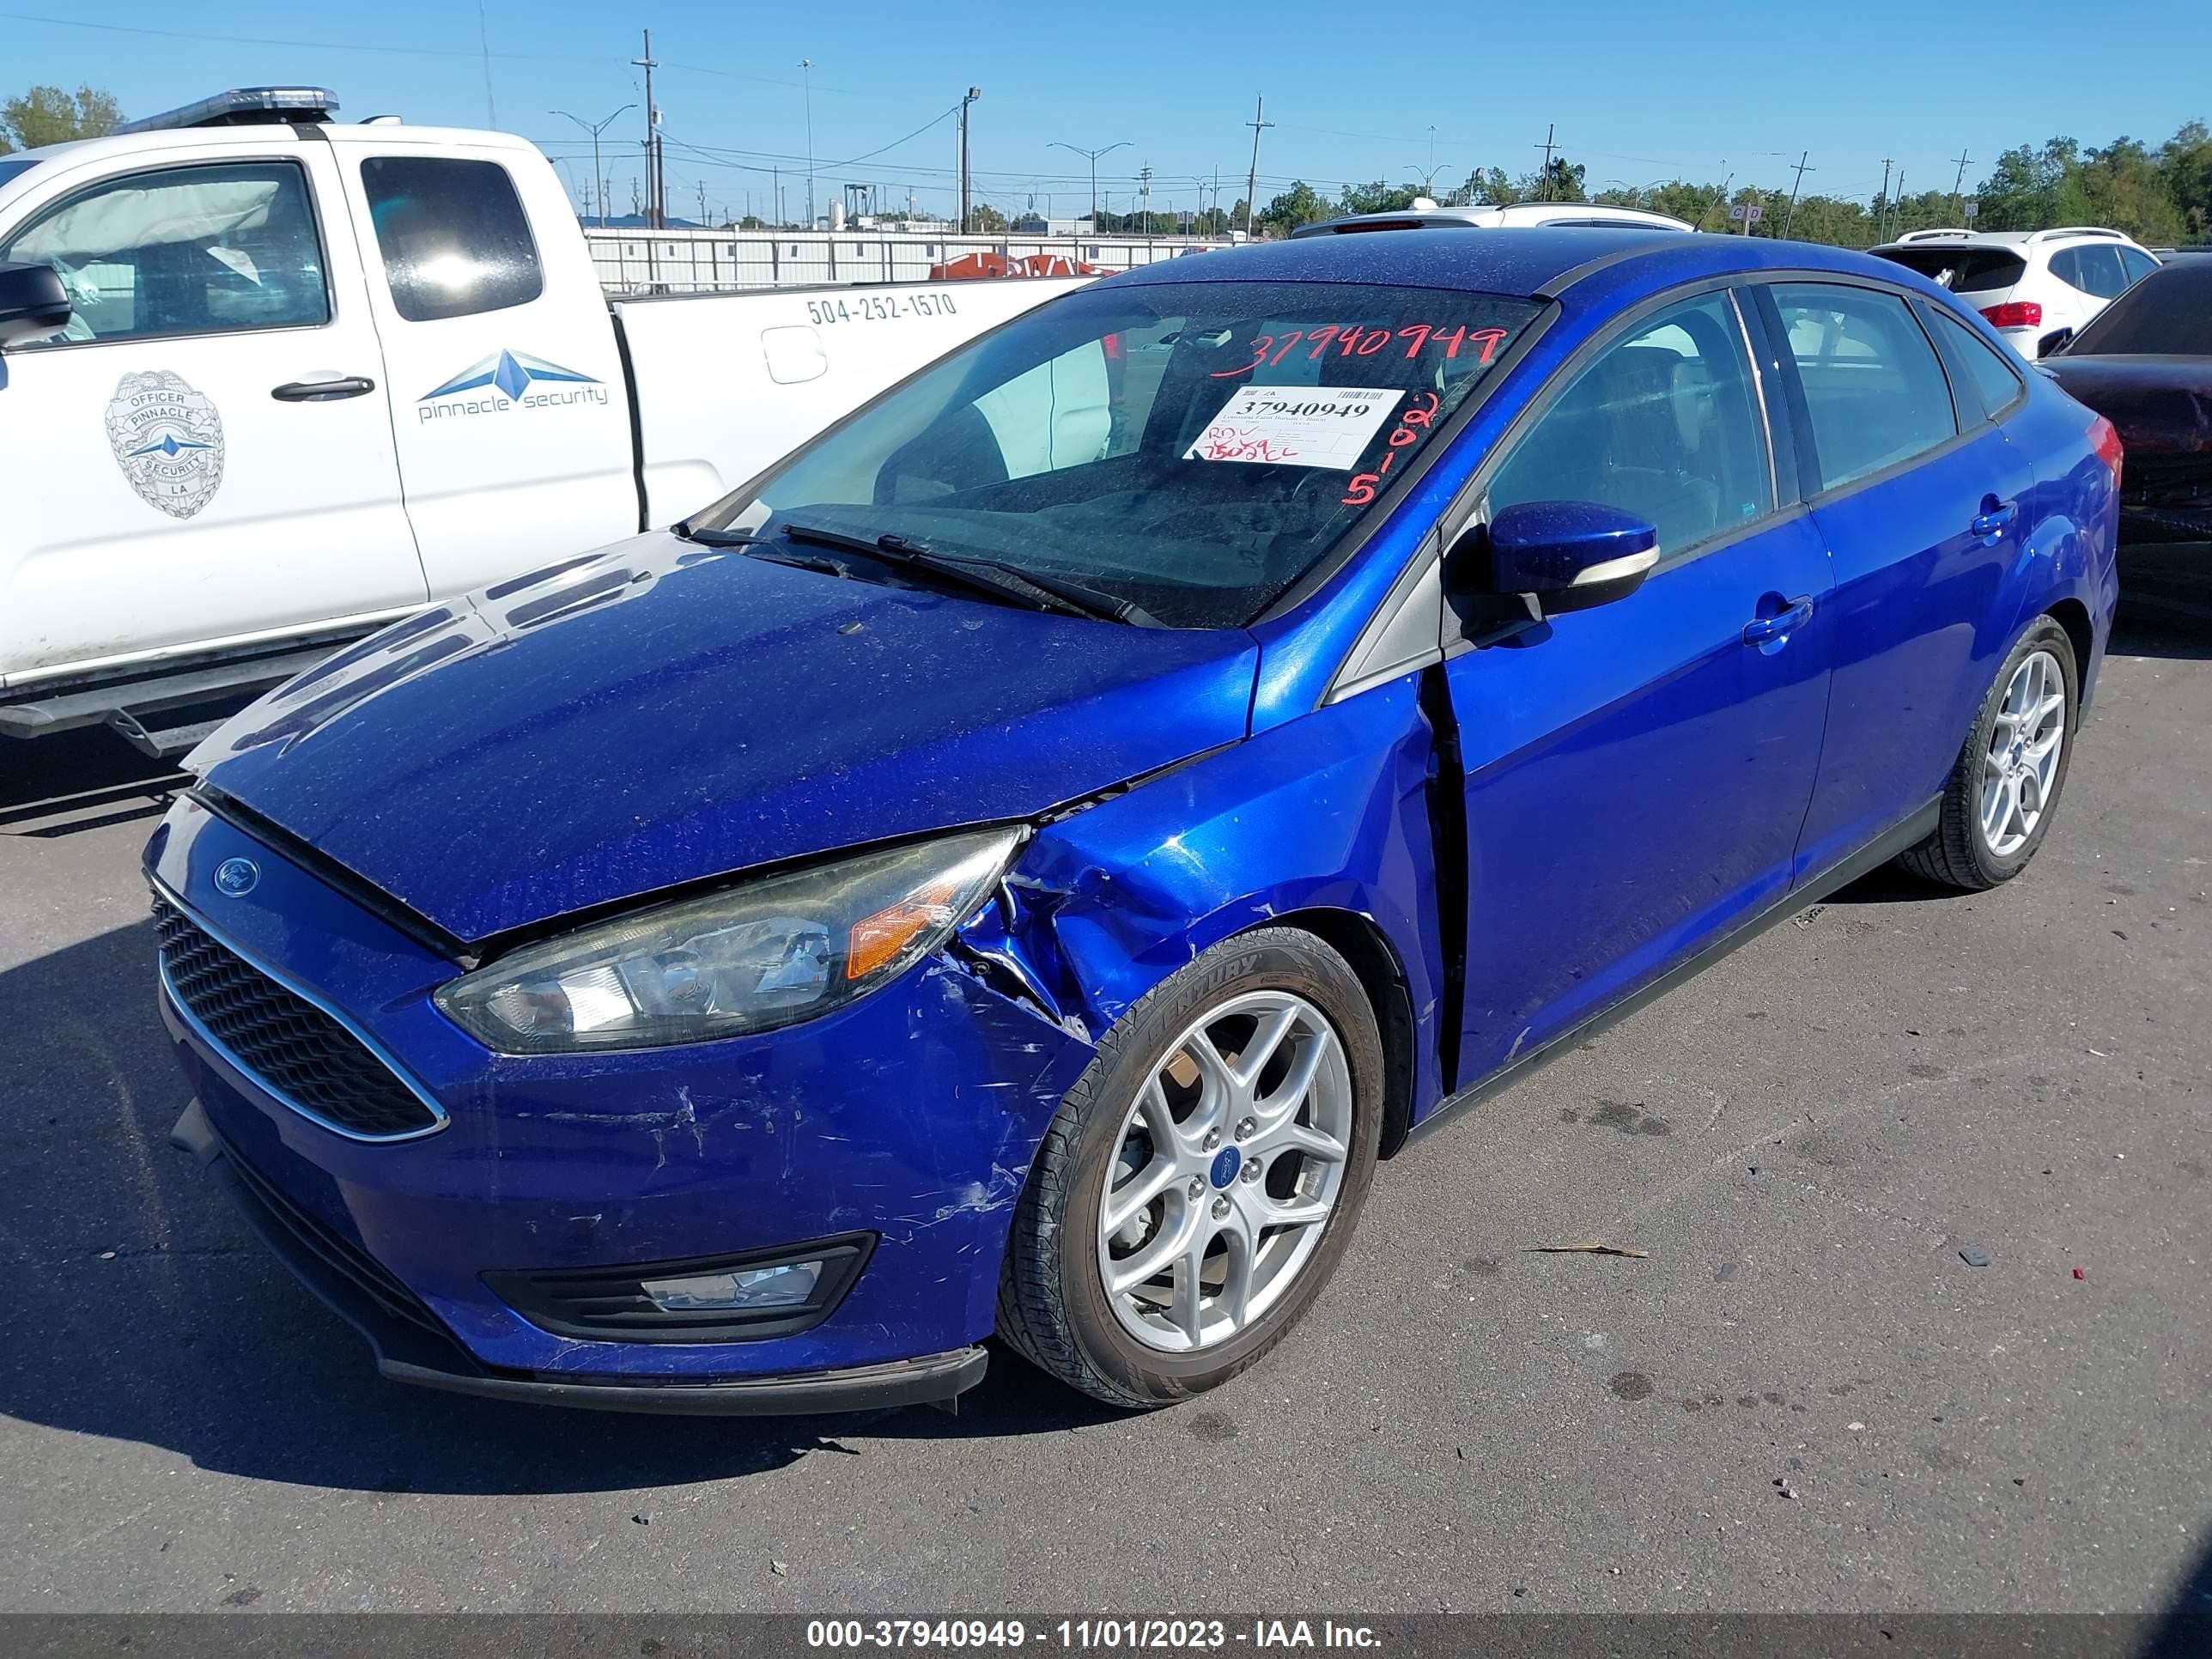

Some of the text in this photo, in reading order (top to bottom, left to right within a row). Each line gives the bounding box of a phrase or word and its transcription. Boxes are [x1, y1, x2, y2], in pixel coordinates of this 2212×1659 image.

[807, 294, 957, 325] 504-252-1570
[1209, 325, 1508, 377] 37940949
[131, 392, 185, 407] OFFICER
[419, 386, 608, 424] pinnacle security
[1236, 401, 1370, 418] 37940949
[131, 407, 193, 426] PINNACLE
[1341, 392, 1438, 505] 2015
[145, 455, 200, 475] SECURITY
[172, 485, 187, 495] LA
